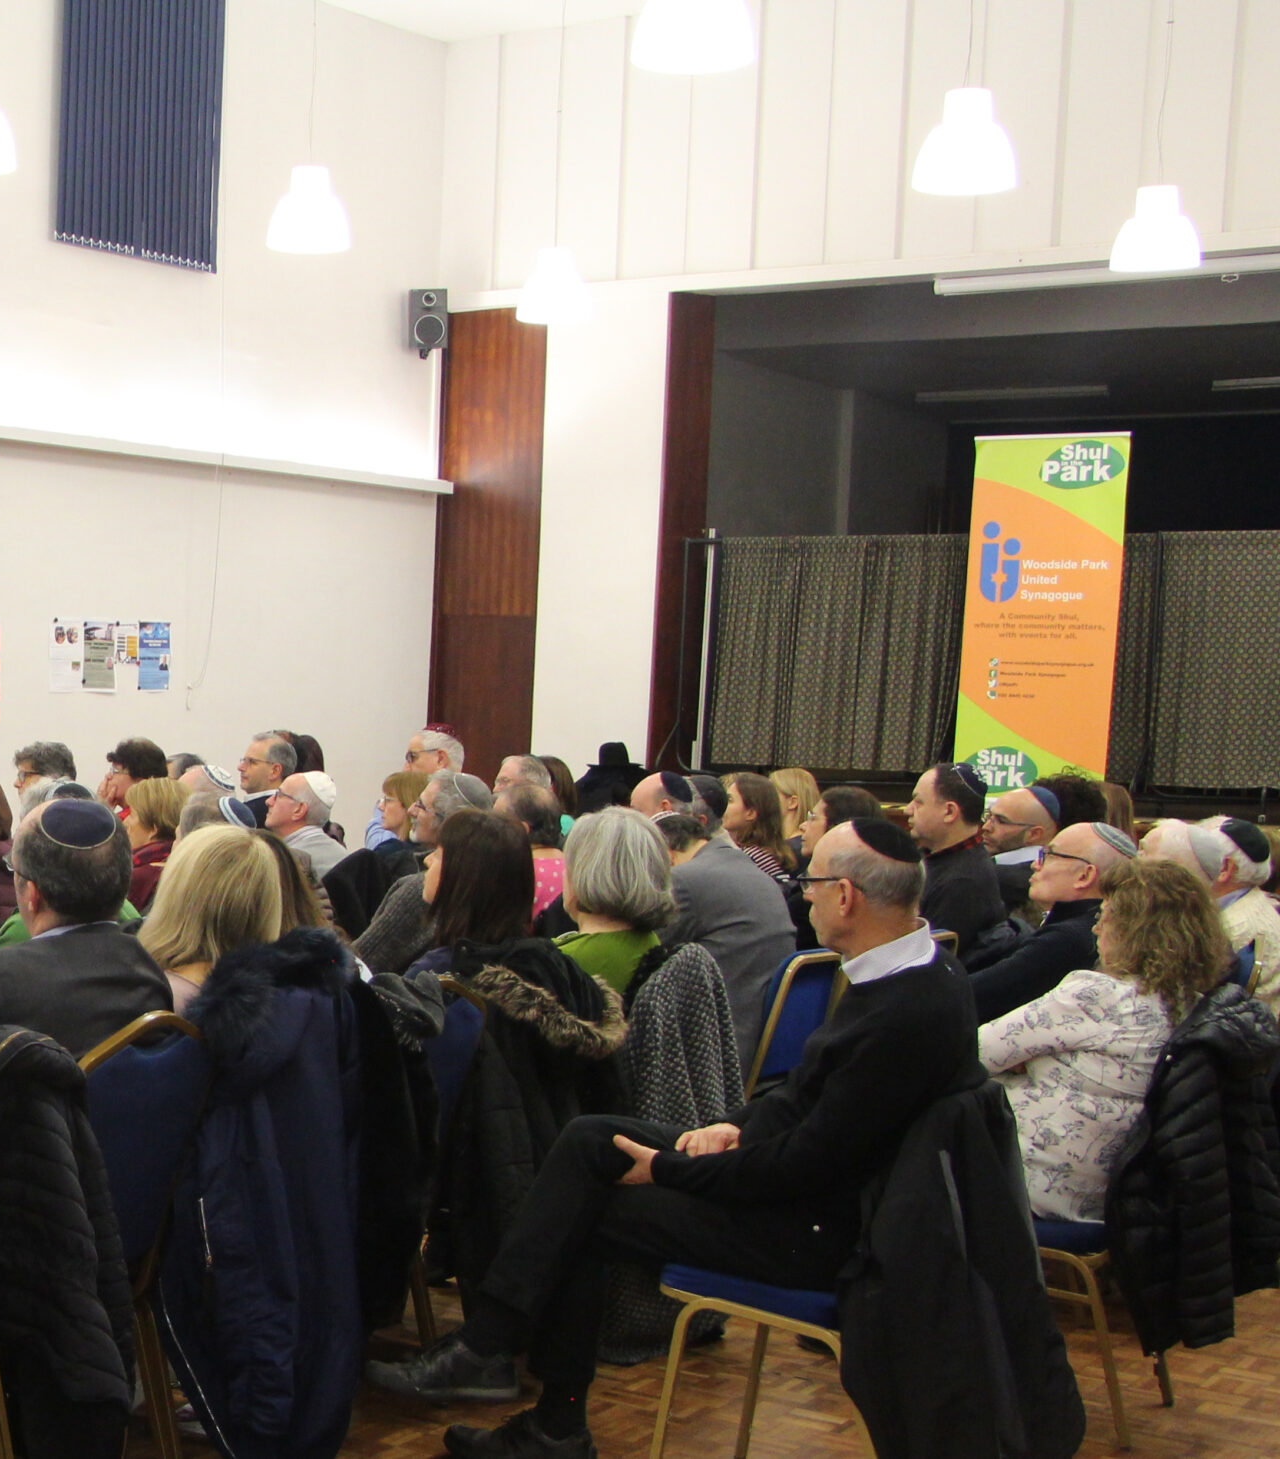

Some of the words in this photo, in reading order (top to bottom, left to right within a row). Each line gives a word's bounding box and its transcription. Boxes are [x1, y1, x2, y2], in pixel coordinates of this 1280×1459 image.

[1060, 443, 1109, 460] Shul
[1042, 459, 1111, 482] Park
[1022, 559, 1078, 570] Woodside
[1081, 559, 1109, 570] Park
[1021, 575, 1058, 585] United
[1020, 590, 1084, 602] Synagogue
[999, 612, 1006, 620] A
[1008, 612, 1056, 622] Community
[973, 621, 1000, 629] where
[1019, 622, 1066, 631] community
[998, 631, 1017, 639] with
[976, 748, 1024, 767] Shul
[978, 766, 1025, 788] ark
